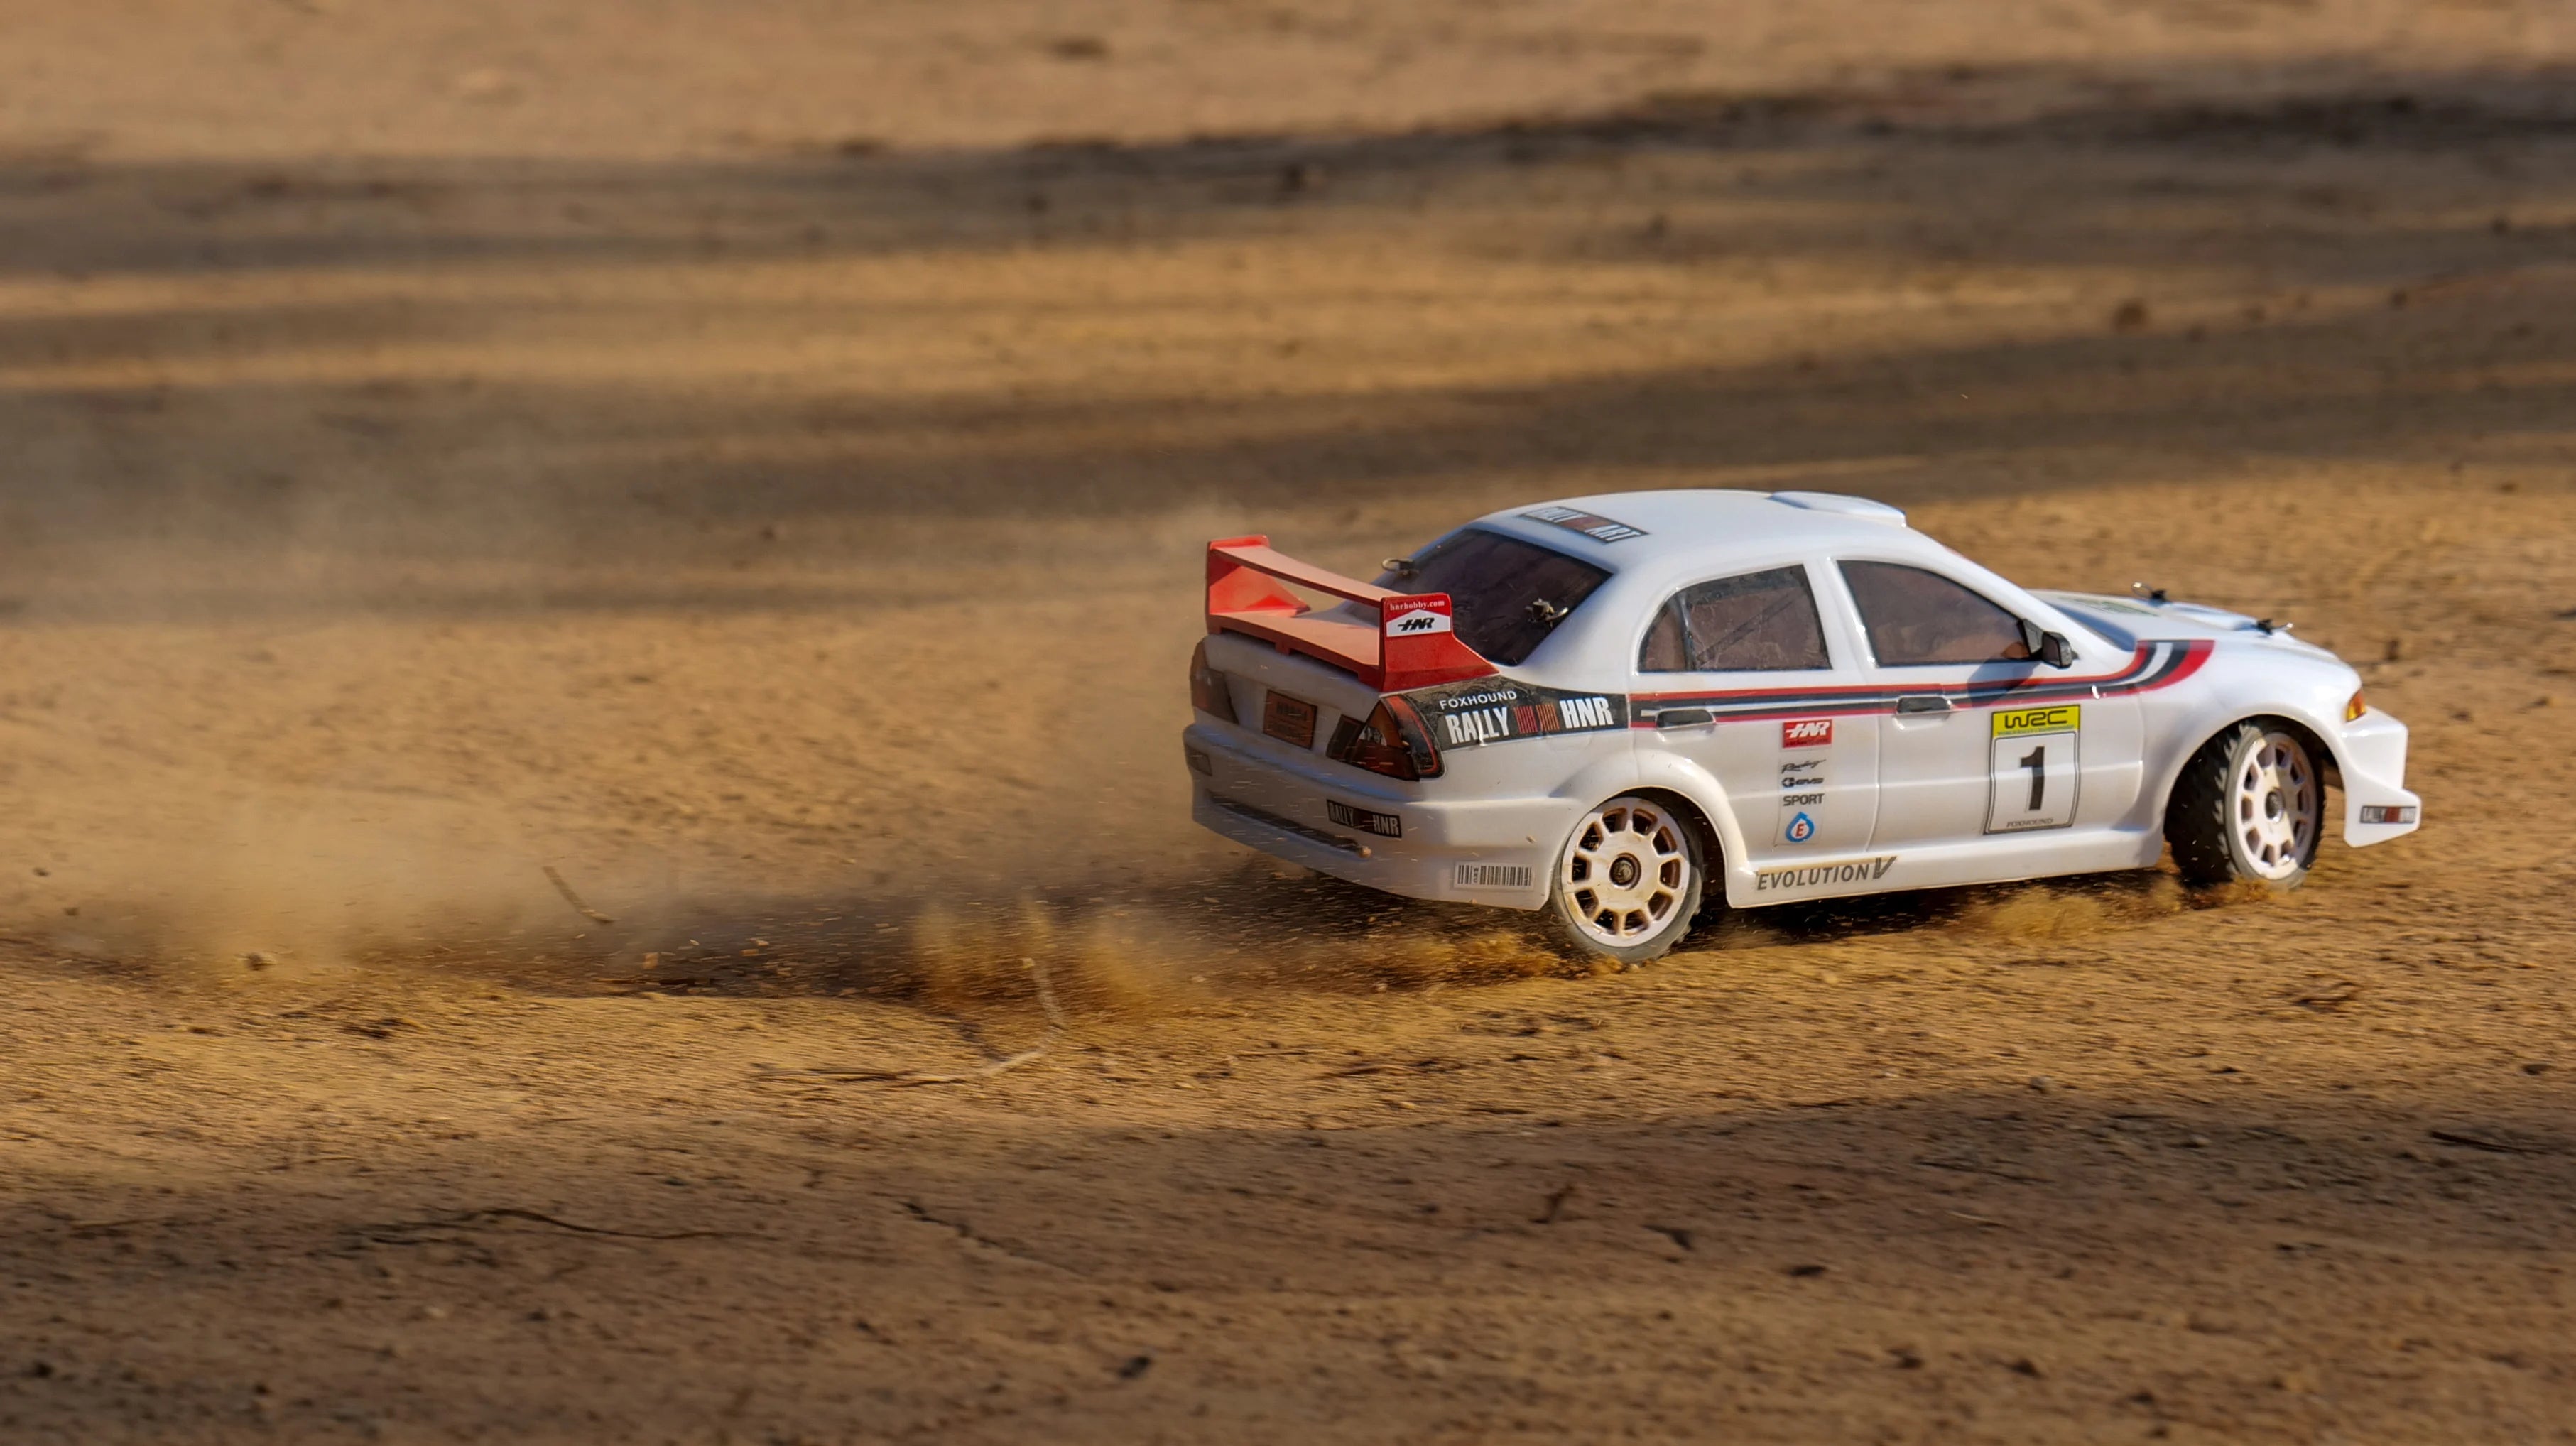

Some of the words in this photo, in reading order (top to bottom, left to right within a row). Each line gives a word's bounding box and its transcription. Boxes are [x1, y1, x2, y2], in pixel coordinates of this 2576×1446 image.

[1389, 600, 1445, 611] hnrhobby.com
[1397, 617, 1435, 631] HNR
[1439, 690, 1517, 710] FOXHOUND
[1445, 707, 1510, 745] RALLY
[1559, 697, 1614, 729] HNR
[2004, 710, 2067, 729] WRC
[1786, 721, 1830, 739] HNR
[2020, 746, 2045, 811] 1
[1783, 793, 1825, 807] SPORT
[1328, 802, 1354, 827] RALLY
[1372, 814, 1400, 836] HNR
[1795, 823, 1805, 837] E
[1757, 863, 1870, 890] EVOLUTION
